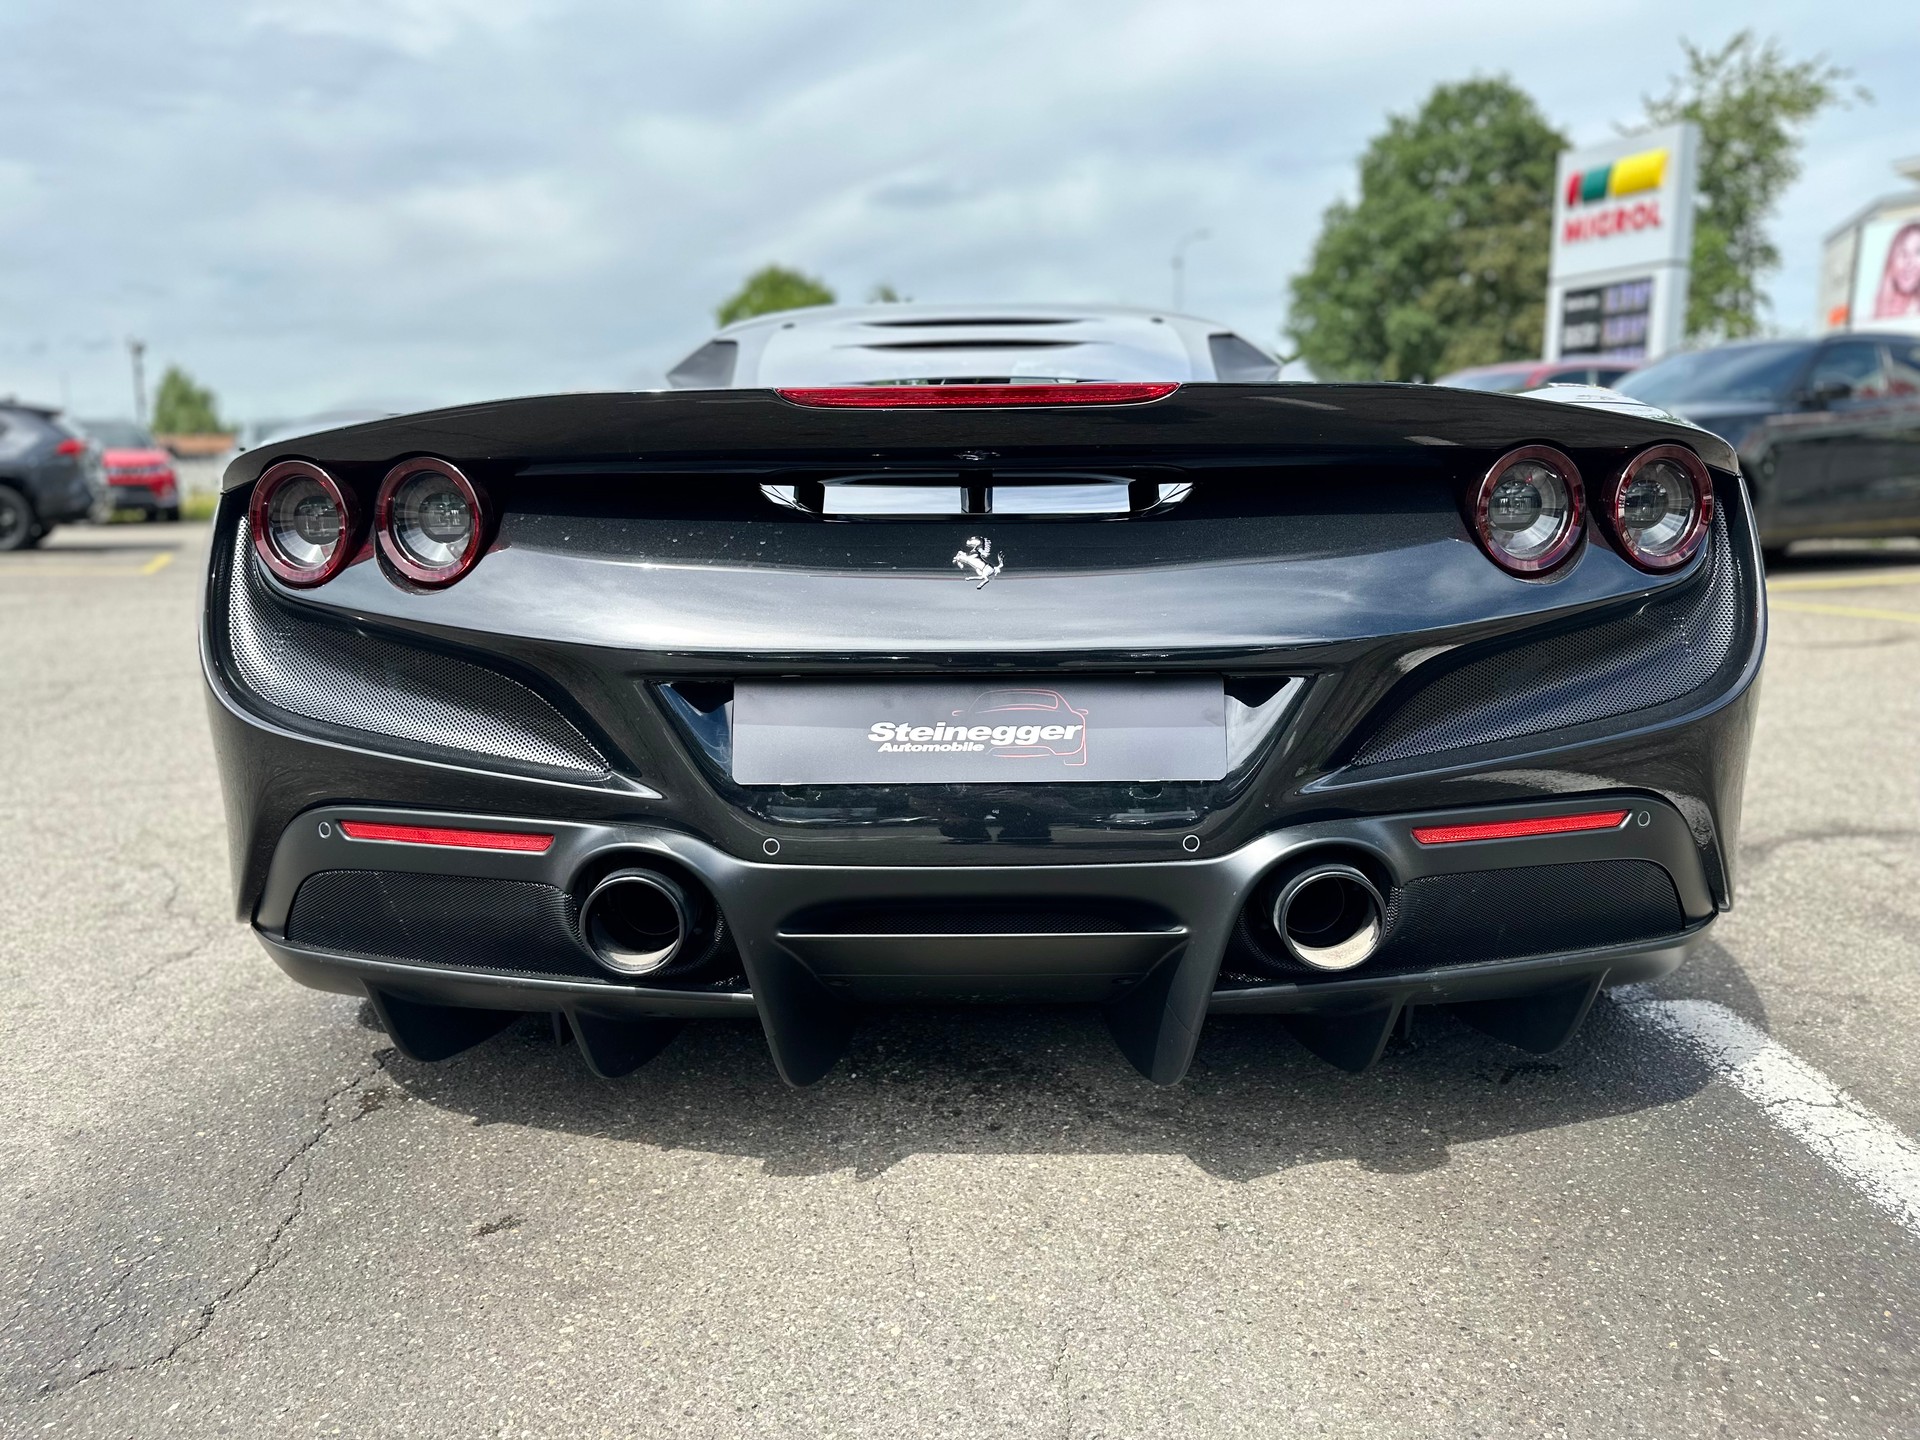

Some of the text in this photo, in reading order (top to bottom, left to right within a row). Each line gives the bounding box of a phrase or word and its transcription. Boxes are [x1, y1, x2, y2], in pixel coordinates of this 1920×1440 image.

[1562, 203, 1663, 243] MIGROL
[867, 721, 1084, 746] Steinegger
[877, 741, 985, 753] Automobile
